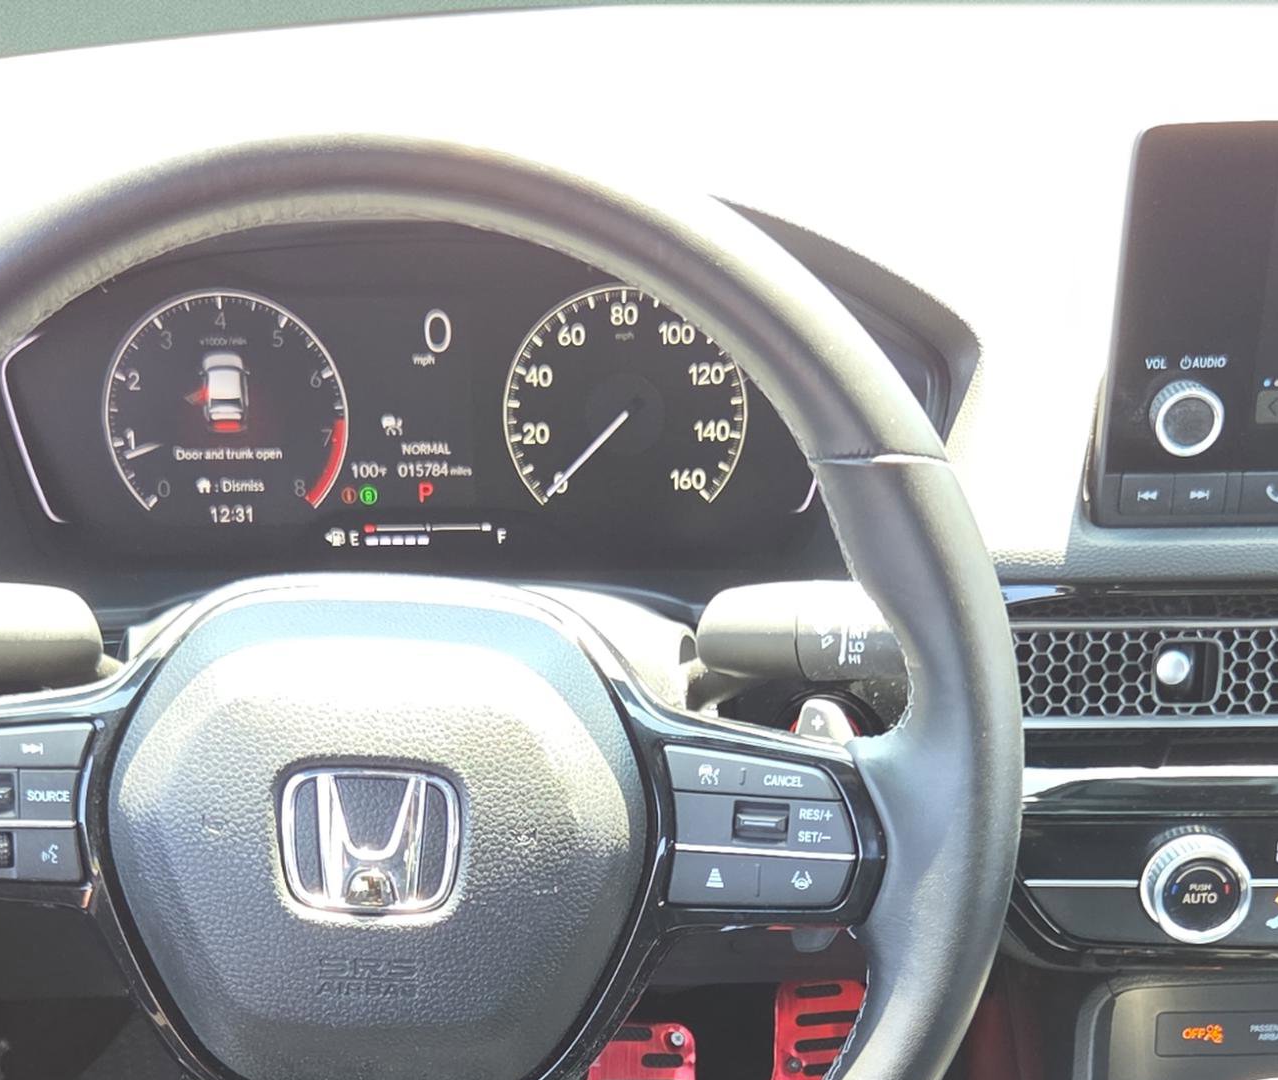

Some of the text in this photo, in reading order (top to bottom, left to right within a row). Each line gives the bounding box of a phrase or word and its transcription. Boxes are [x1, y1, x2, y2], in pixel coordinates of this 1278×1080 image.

[214, 311, 226, 329] 4
[609, 302, 639, 326] 80
[272, 329, 284, 348] 5
[423, 308, 452, 353] 0
[557, 322, 586, 346] 60
[657, 321, 696, 346] 100
[160, 330, 173, 350] 3
[411, 353, 436, 367] mph
[1144, 357, 1168, 370] VOL
[1192, 355, 1228, 369] AUDIO
[128, 371, 142, 391] 2
[309, 370, 322, 388] 6
[524, 363, 553, 388] 40
[687, 362, 726, 386] 120
[125, 428, 136, 450] 1
[521, 421, 550, 445] 20
[692, 418, 731, 443] 140
[174, 449, 283, 464] Door and trunk open
[401, 441, 452, 456] NORMAL
[397, 461, 449, 478] 015784
[222, 478, 265, 493] Dismiss
[669, 467, 707, 491] 160
[157, 480, 171, 498] 0
[294, 479, 306, 498] 8
[417, 481, 434, 503] P
[209, 505, 254, 524] 12:31
[349, 529, 360, 547] E
[496, 527, 508, 545] F
[848, 640, 865, 653] LO
[848, 653, 862, 665] HI
[763, 774, 804, 789] CANCEL
[26, 789, 71, 803] SOURCE
[798, 808, 834, 822] RES/+
[1188, 883, 1212, 892] PUSH
[1182, 892, 1219, 905] AUTO
[1181, 1026, 1206, 1040] OFF
